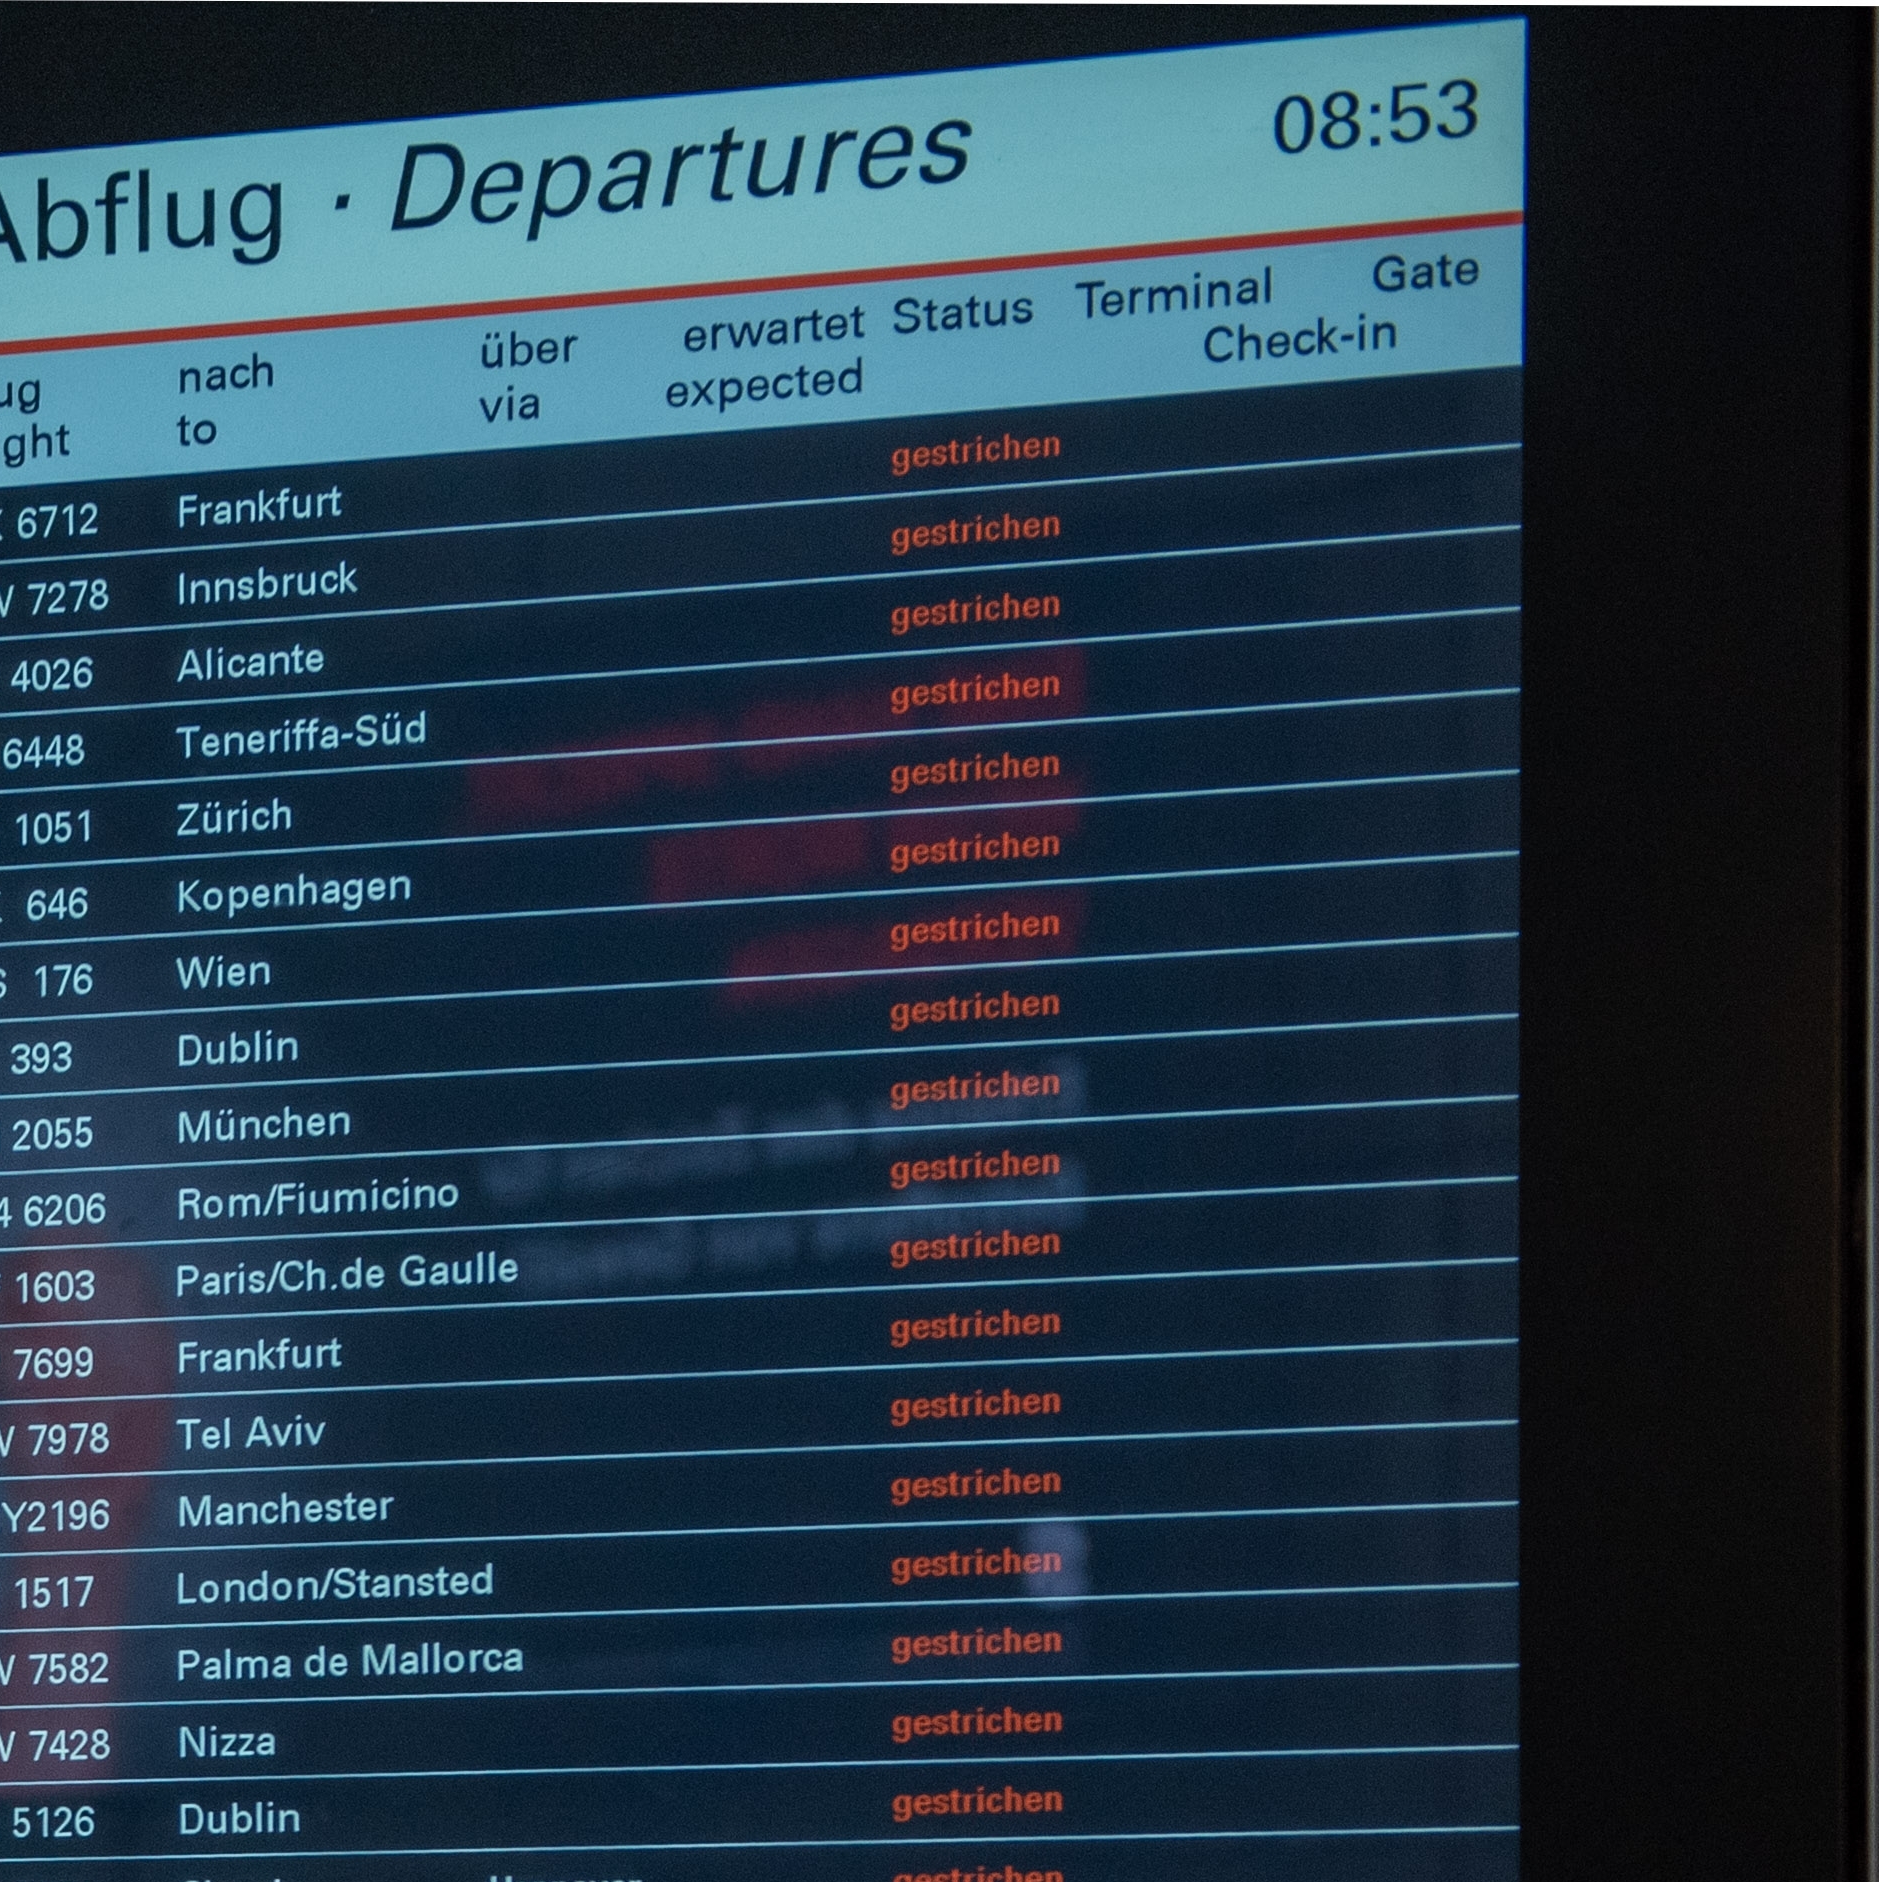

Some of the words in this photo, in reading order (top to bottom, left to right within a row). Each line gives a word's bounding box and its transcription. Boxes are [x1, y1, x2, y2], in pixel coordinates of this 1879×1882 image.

[1274, 77, 1480, 155] 08:53
[389, 114, 974, 242] Departures
[179, 352, 274, 394] nach
[481, 330, 578, 369] über
[683, 305, 865, 352] erwartet
[893, 295, 1034, 335] Status
[1075, 265, 1273, 318] Terminal
[1373, 253, 1481, 293] Gate
[177, 415, 218, 447] to
[479, 384, 540, 423] via
[665, 356, 863, 414] expected
[1204, 316, 1398, 363] Check-in
[16, 501, 99, 540] 6712
[177, 485, 343, 529] Frankfurt
[891, 434, 1061, 475] gestrichen
[9, 655, 94, 693] 4026
[176, 642, 325, 683] Alicante
[891, 593, 1060, 635] gestrichen
[2, 732, 86, 771] 6448
[174, 709, 427, 760] Teneriffa-Süd
[890, 672, 1061, 715] gestrichen
[25, 885, 89, 923] 646
[177, 872, 412, 919] Kopenhagen
[890, 831, 1060, 873] gestrichen
[34, 962, 94, 998] 176
[175, 954, 272, 991] Wien
[889, 911, 1061, 953] gestrichen
[11, 1115, 94, 1153] 2055
[177, 1105, 352, 1144] München
[891, 1071, 1059, 1109] gestrichen
[23, 1191, 107, 1228] 6206
[177, 1176, 460, 1221] Rom/Fiumicino
[890, 1150, 1060, 1189] gestrichen
[12, 1345, 94, 1381] 7699
[177, 1336, 343, 1375] Frankfurt
[890, 1309, 1061, 1347] gestrichen
[178, 1491, 396, 1528] Manchester
[891, 1468, 1061, 1506] gestrichen
[14, 1574, 95, 1610] 1517
[176, 1561, 494, 1606] London/Stansted
[891, 1548, 1060, 1585] gestrichen
[27, 1651, 110, 1686] 7582
[176, 1647, 292, 1682] Palma
[303, 1644, 349, 1679] de
[361, 1641, 525, 1677] Mallorca
[892, 1627, 1062, 1663] gestrichen
[11, 1805, 96, 1839] 5126
[178, 1800, 301, 1836] Dublin
[892, 1786, 1063, 1822] gestrichen
